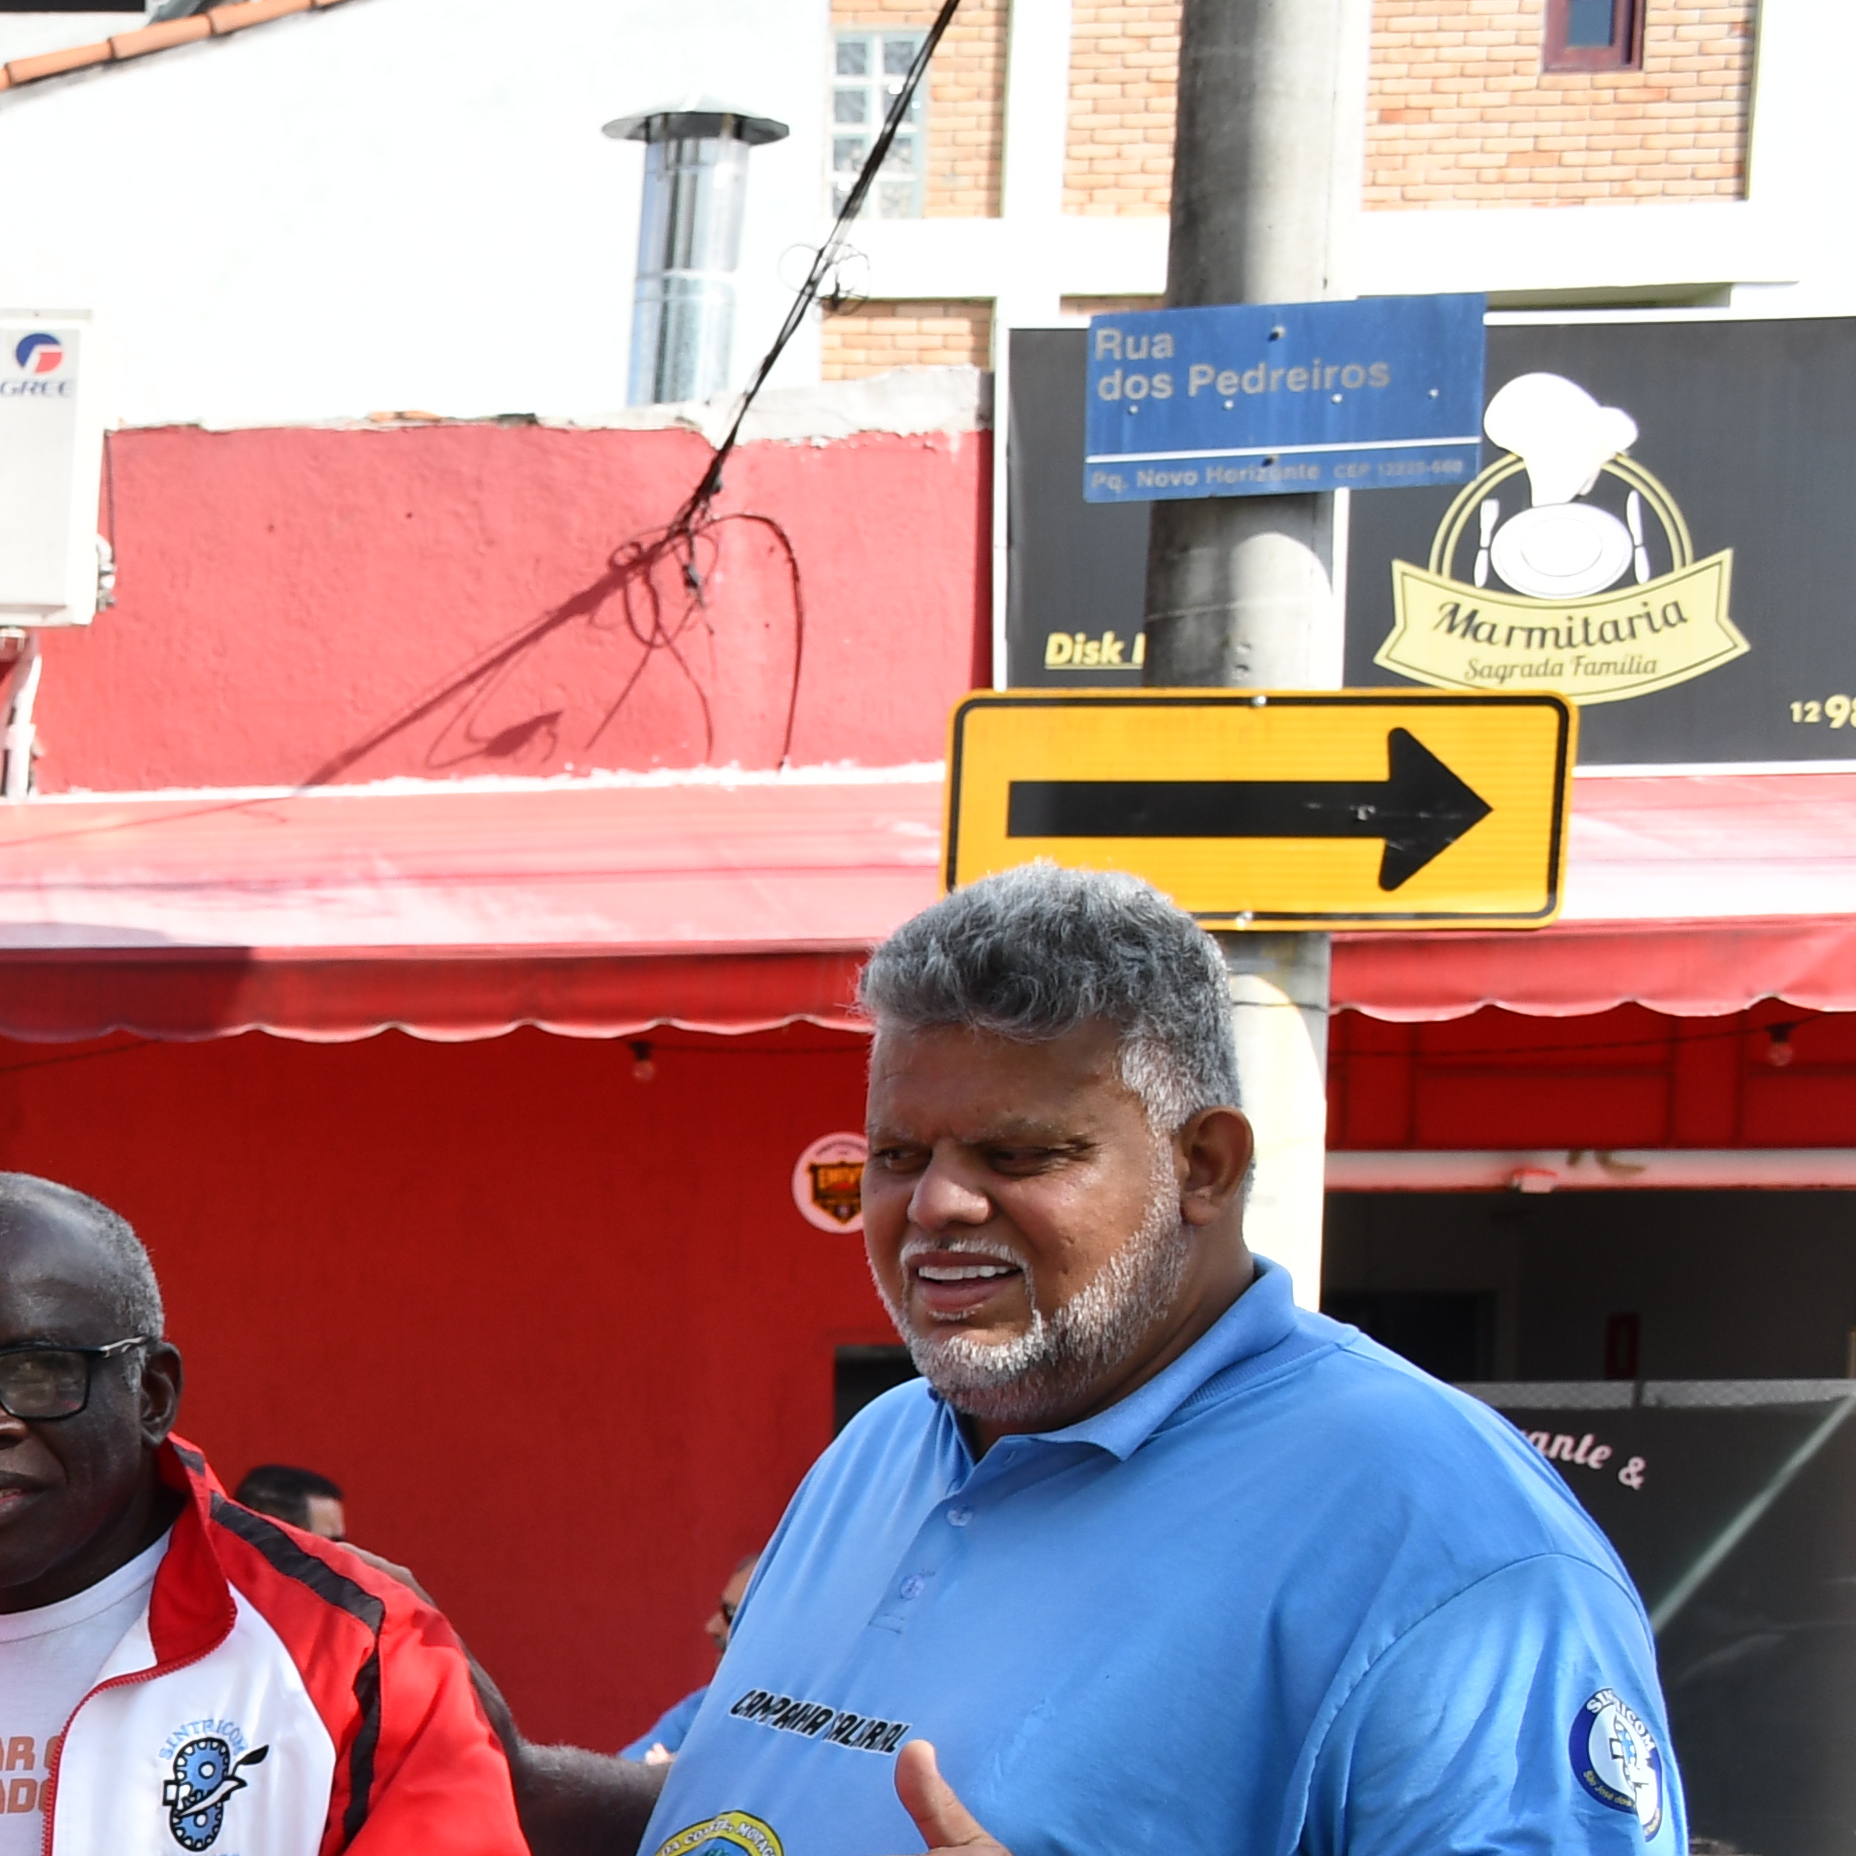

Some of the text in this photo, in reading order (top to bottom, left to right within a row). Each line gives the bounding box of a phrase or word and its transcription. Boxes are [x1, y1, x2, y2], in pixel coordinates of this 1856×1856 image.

[1095, 327, 1175, 361] Rua
[1097, 358, 1391, 401] dos Pedreiros
[1136, 468, 1199, 489] Novo
[1433, 599, 1689, 650] Marmitaria
[1045, 630, 1126, 666] Disk
[1464, 654, 1659, 685] Sagrada Família
[1790, 701, 1821, 724] 12
[1521, 1428, 1614, 1470] ante
